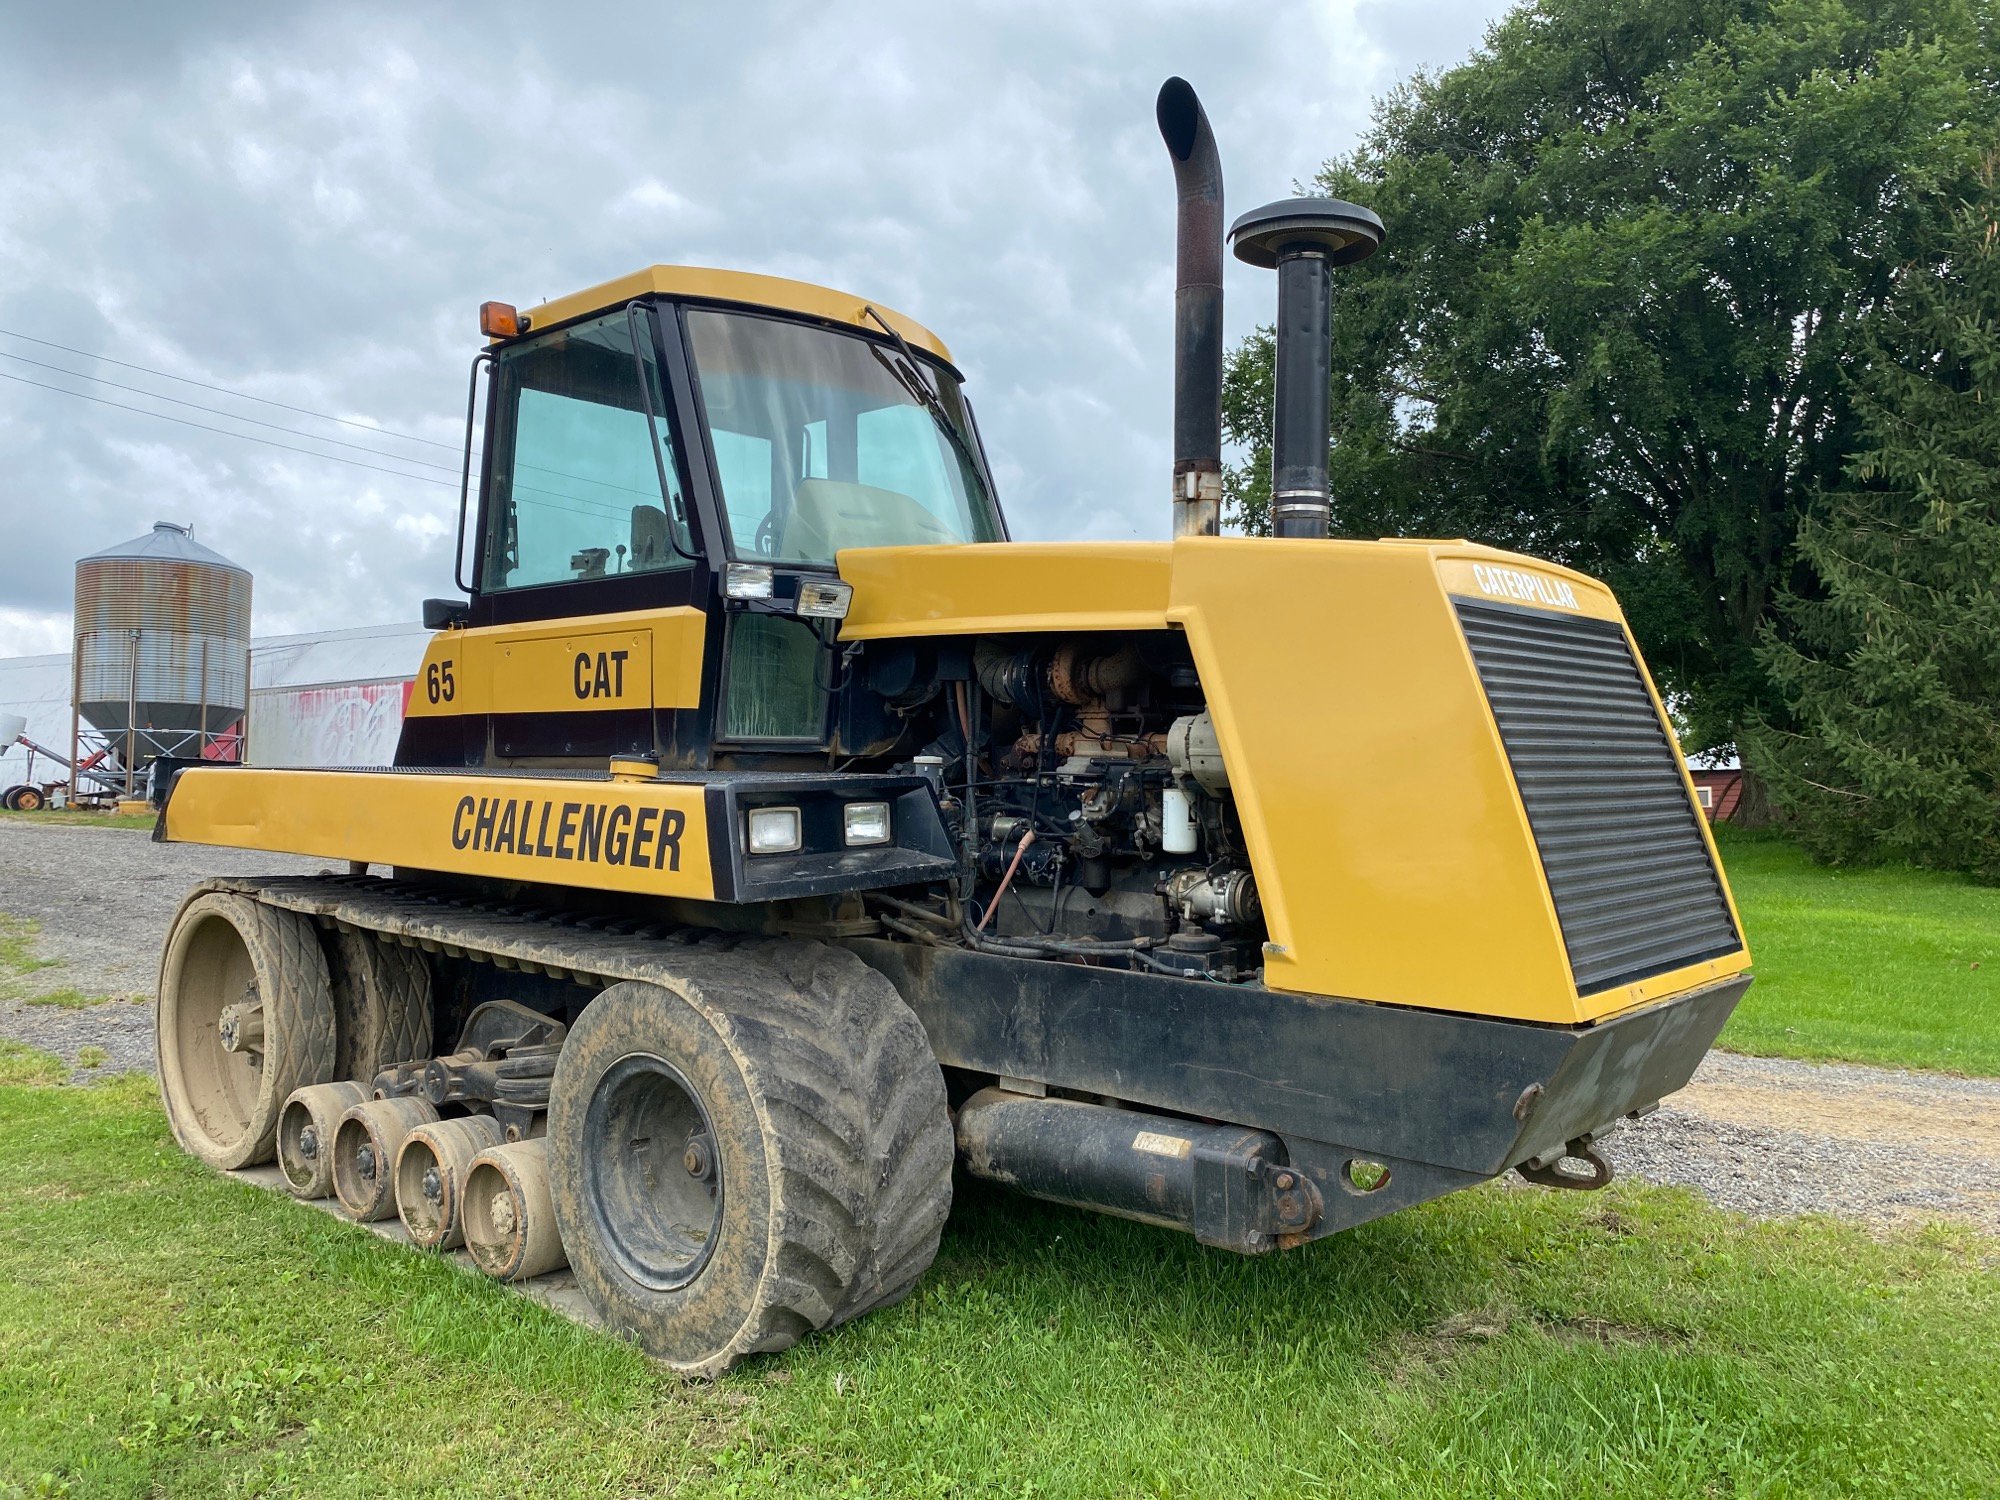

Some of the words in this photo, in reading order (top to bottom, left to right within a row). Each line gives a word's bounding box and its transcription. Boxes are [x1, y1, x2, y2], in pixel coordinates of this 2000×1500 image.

[1472, 563, 1581, 610] CATERPILLAR
[427, 660, 454, 704] 65
[573, 650, 629, 700] CAT
[452, 795, 686, 872] CHALLENGER
